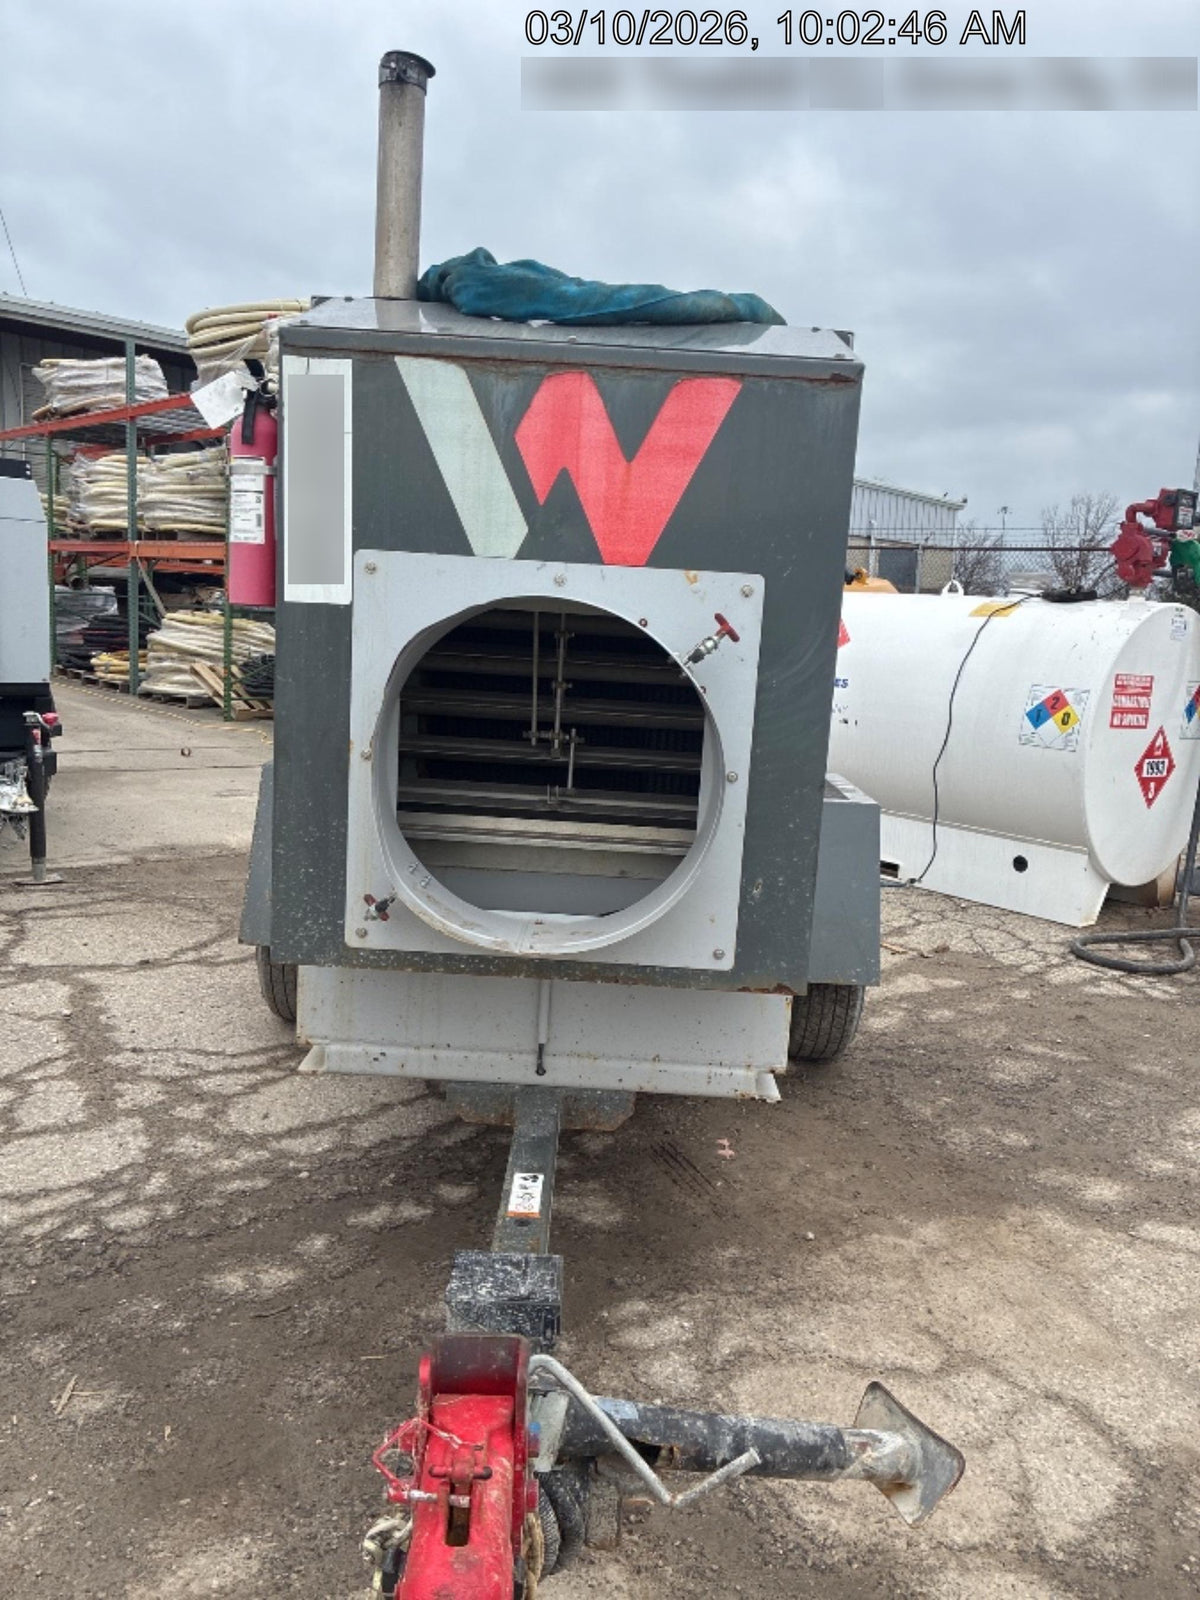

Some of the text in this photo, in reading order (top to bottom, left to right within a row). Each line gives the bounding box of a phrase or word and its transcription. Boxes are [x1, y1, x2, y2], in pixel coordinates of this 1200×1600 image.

[1050, 696, 1061, 710] 2
[1061, 712, 1071, 726] 0
[1146, 760, 1166, 776] 1993
